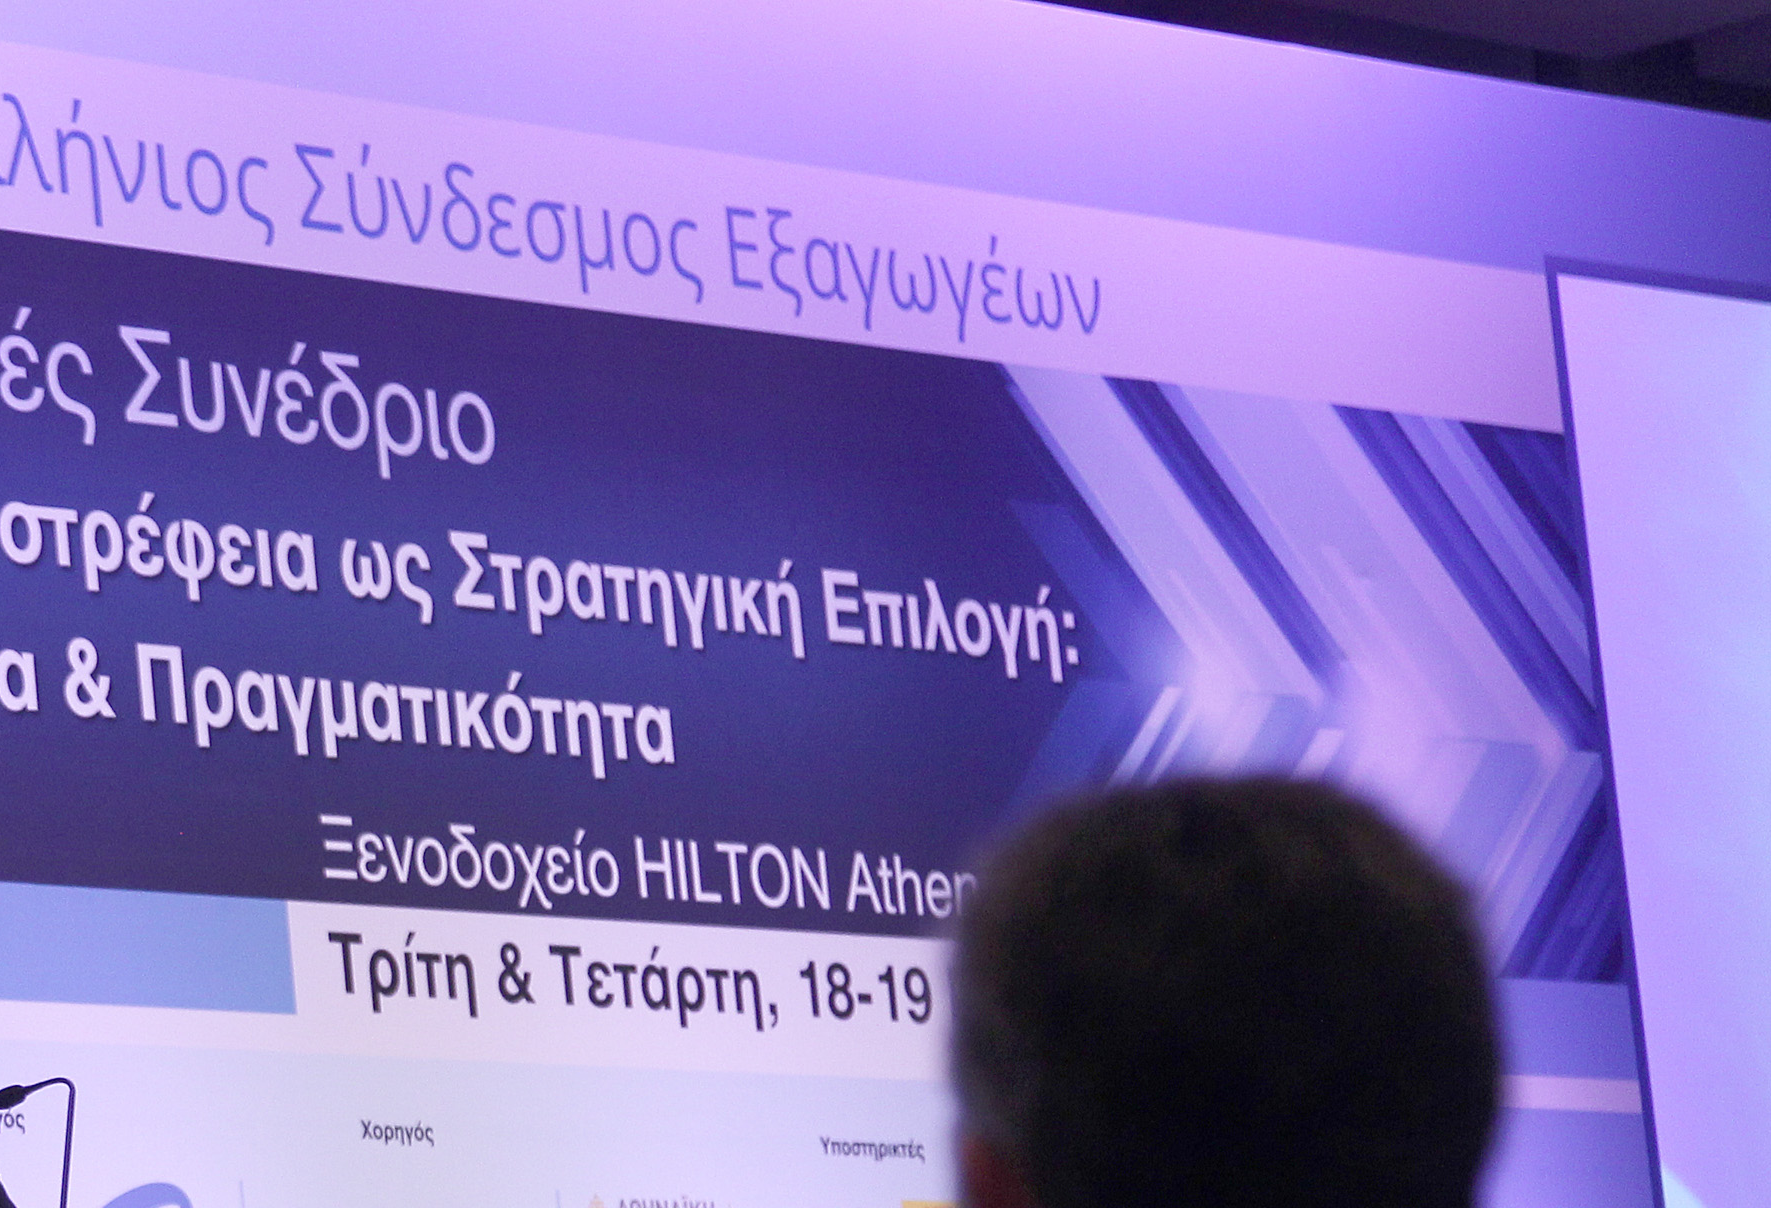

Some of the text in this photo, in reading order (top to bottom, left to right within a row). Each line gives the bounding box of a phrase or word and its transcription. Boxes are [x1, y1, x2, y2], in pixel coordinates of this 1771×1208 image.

[293, 142, 704, 304] Σύνδεσμος
[725, 206, 1101, 342] Εξαγωγέων
[118, 325, 495, 480] Συνέδριο
[341, 537, 433, 625] ως
[447, 529, 806, 659] Στρατηγική
[822, 566, 1080, 684] Επιλογή:
[64, 637, 116, 719] &
[135, 641, 676, 779] Πραγματικότητα
[320, 813, 979, 919] Ξενοδοχείο HILTON Athen
[328, 930, 933, 1032] Τρίτη & Τετάρτη, 18-19
[360, 1118, 435, 1147] Χορηγός
[819, 1135, 926, 1164] Υποστηρικτές
